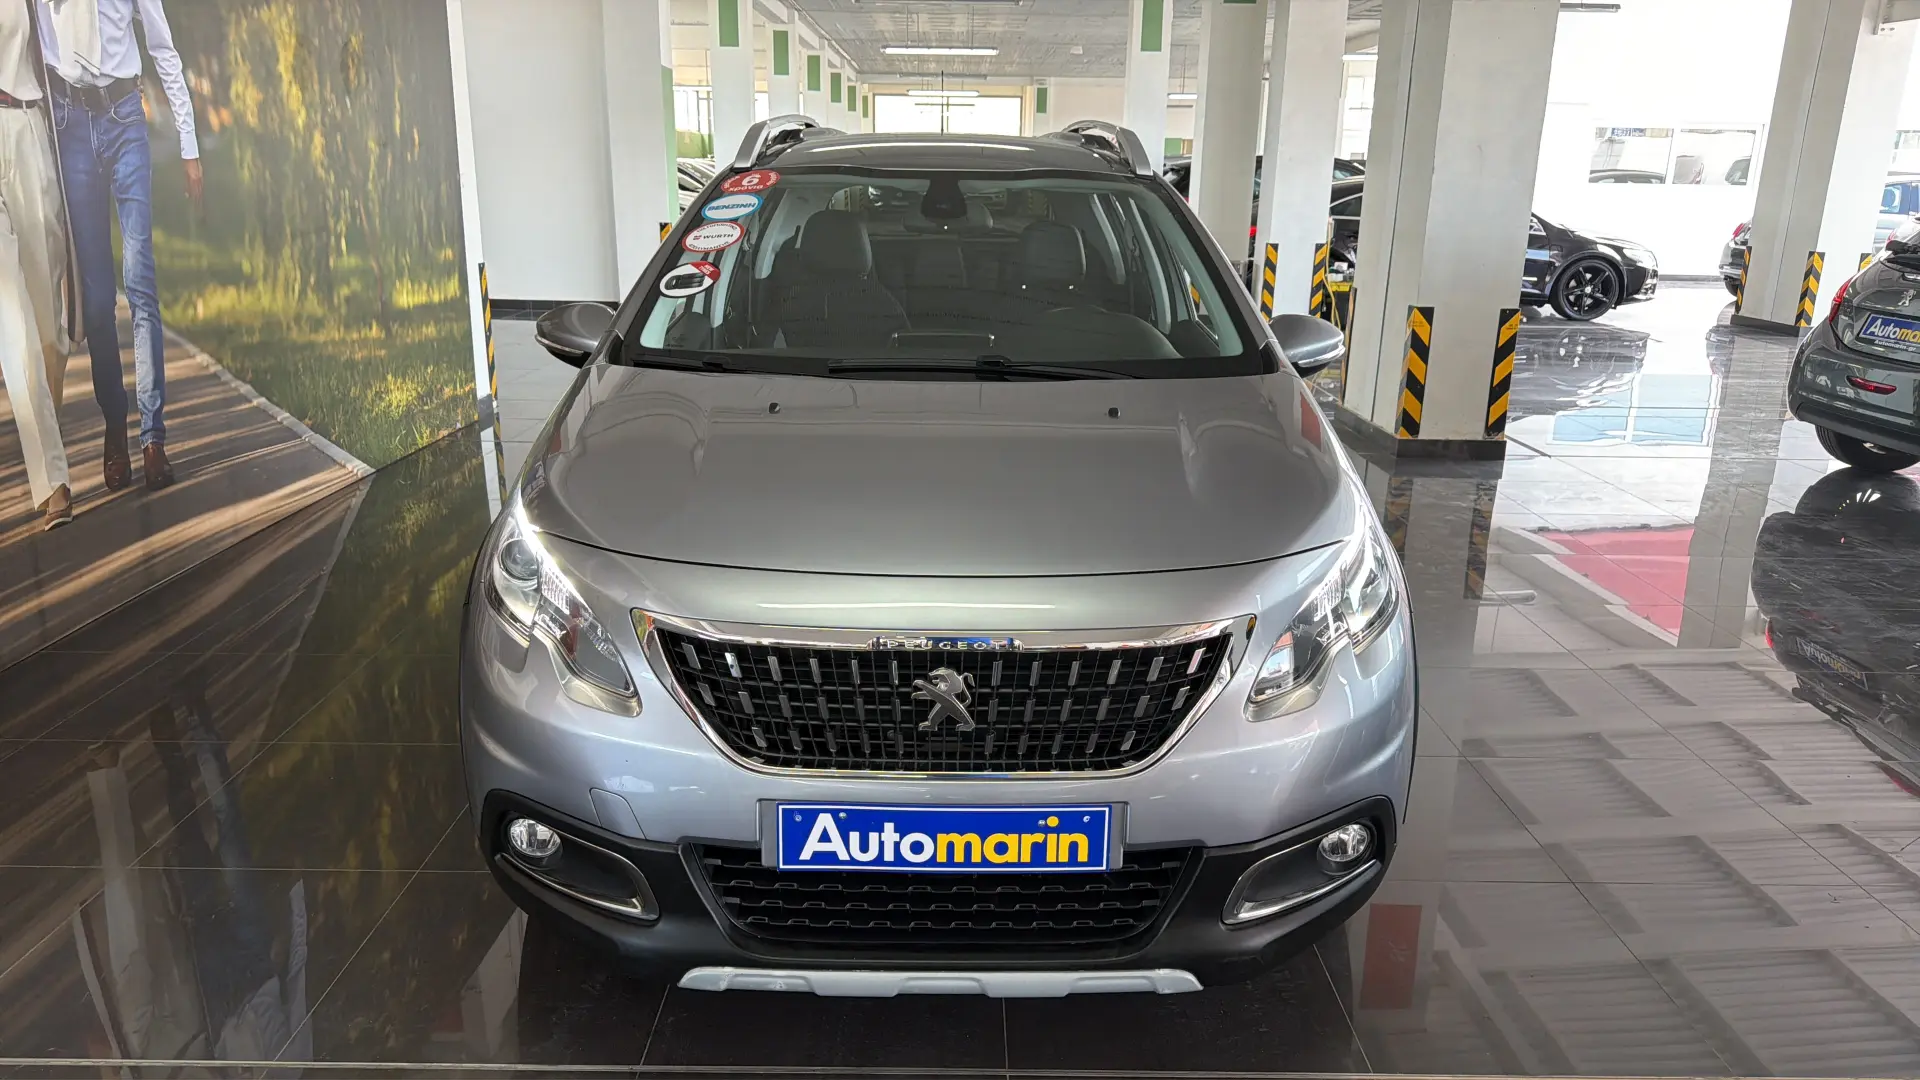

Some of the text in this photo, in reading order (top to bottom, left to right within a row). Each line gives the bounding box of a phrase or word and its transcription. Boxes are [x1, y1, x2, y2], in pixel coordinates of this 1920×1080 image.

[741, 174, 761, 186] 6
[888, 640, 1004, 650] PEUGEOT
[799, 813, 1089, 863] Automarin
